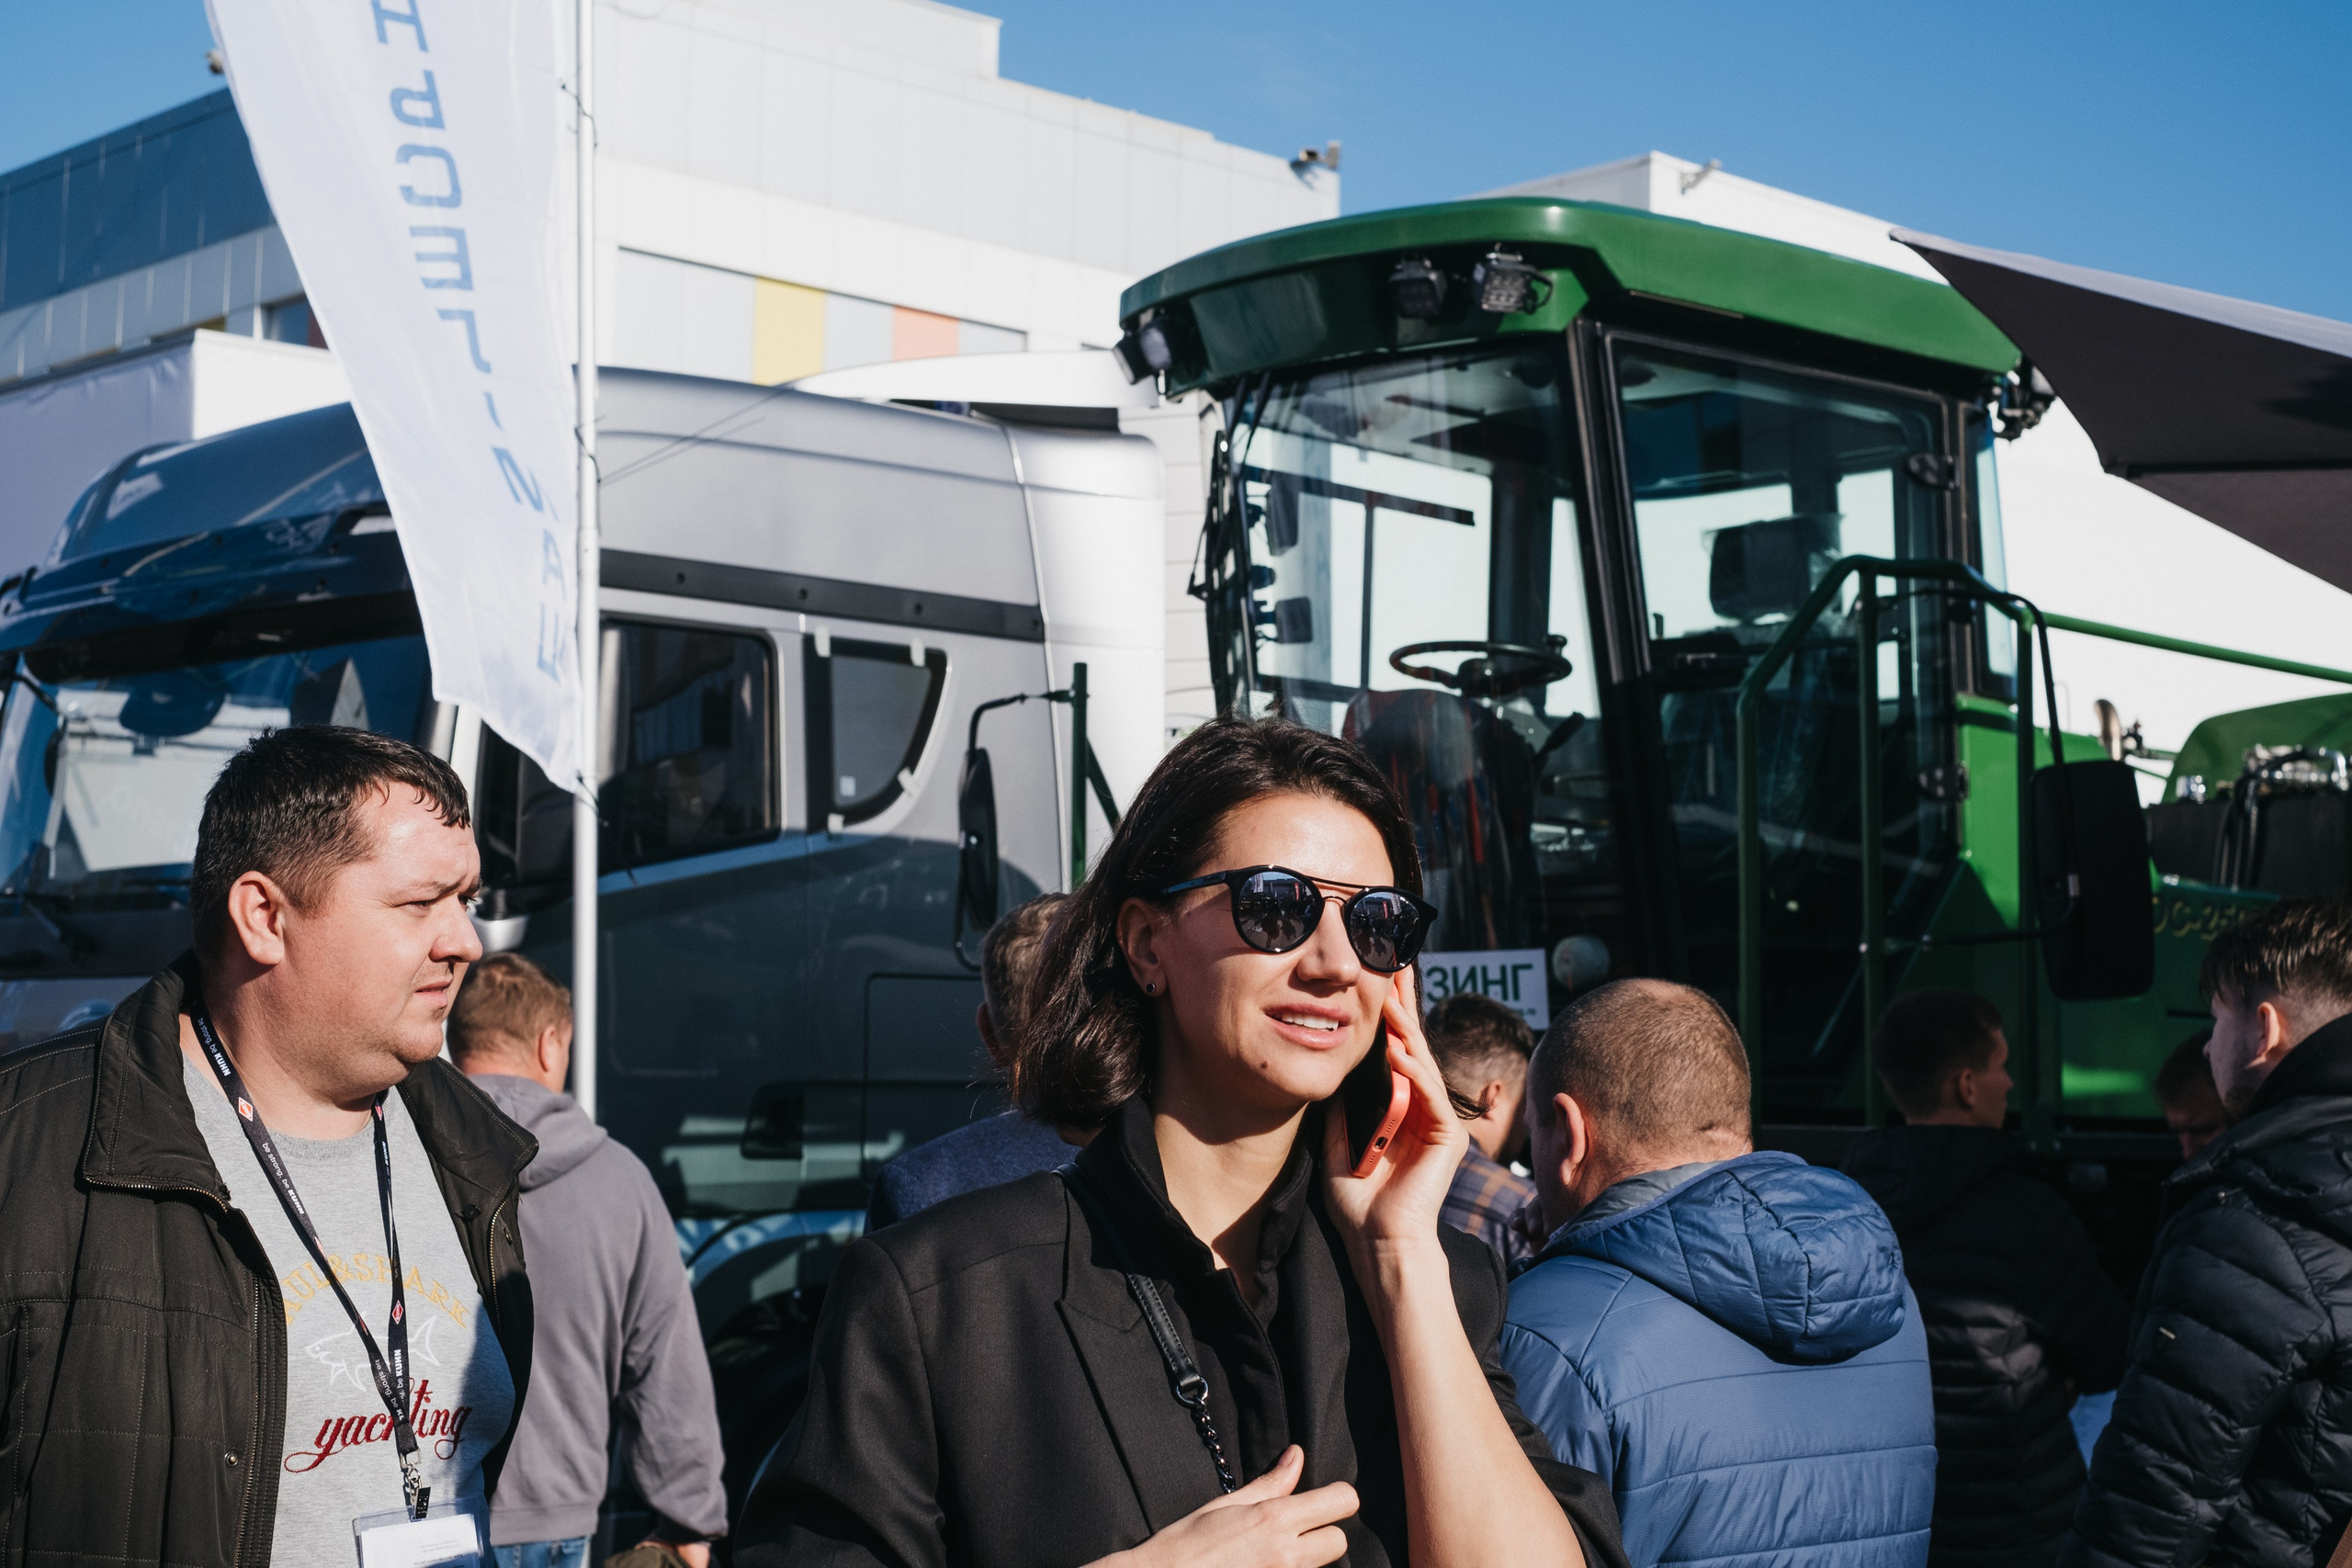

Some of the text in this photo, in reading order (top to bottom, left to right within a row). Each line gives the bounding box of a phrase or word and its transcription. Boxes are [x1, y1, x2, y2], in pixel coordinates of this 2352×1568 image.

[1426, 964, 1533, 1002] ЗИНГ
[198, 1017, 231, 1077] be strong, be KUHN
[262, 1143, 304, 1214] be strong, be KUHN
[284, 1253, 469, 1328] AUL&SHARK
[375, 1359, 380, 1370] be
[379, 1371, 391, 1398] strong,
[390, 1398, 398, 1408] be
[394, 1348, 402, 1377] KUHN
